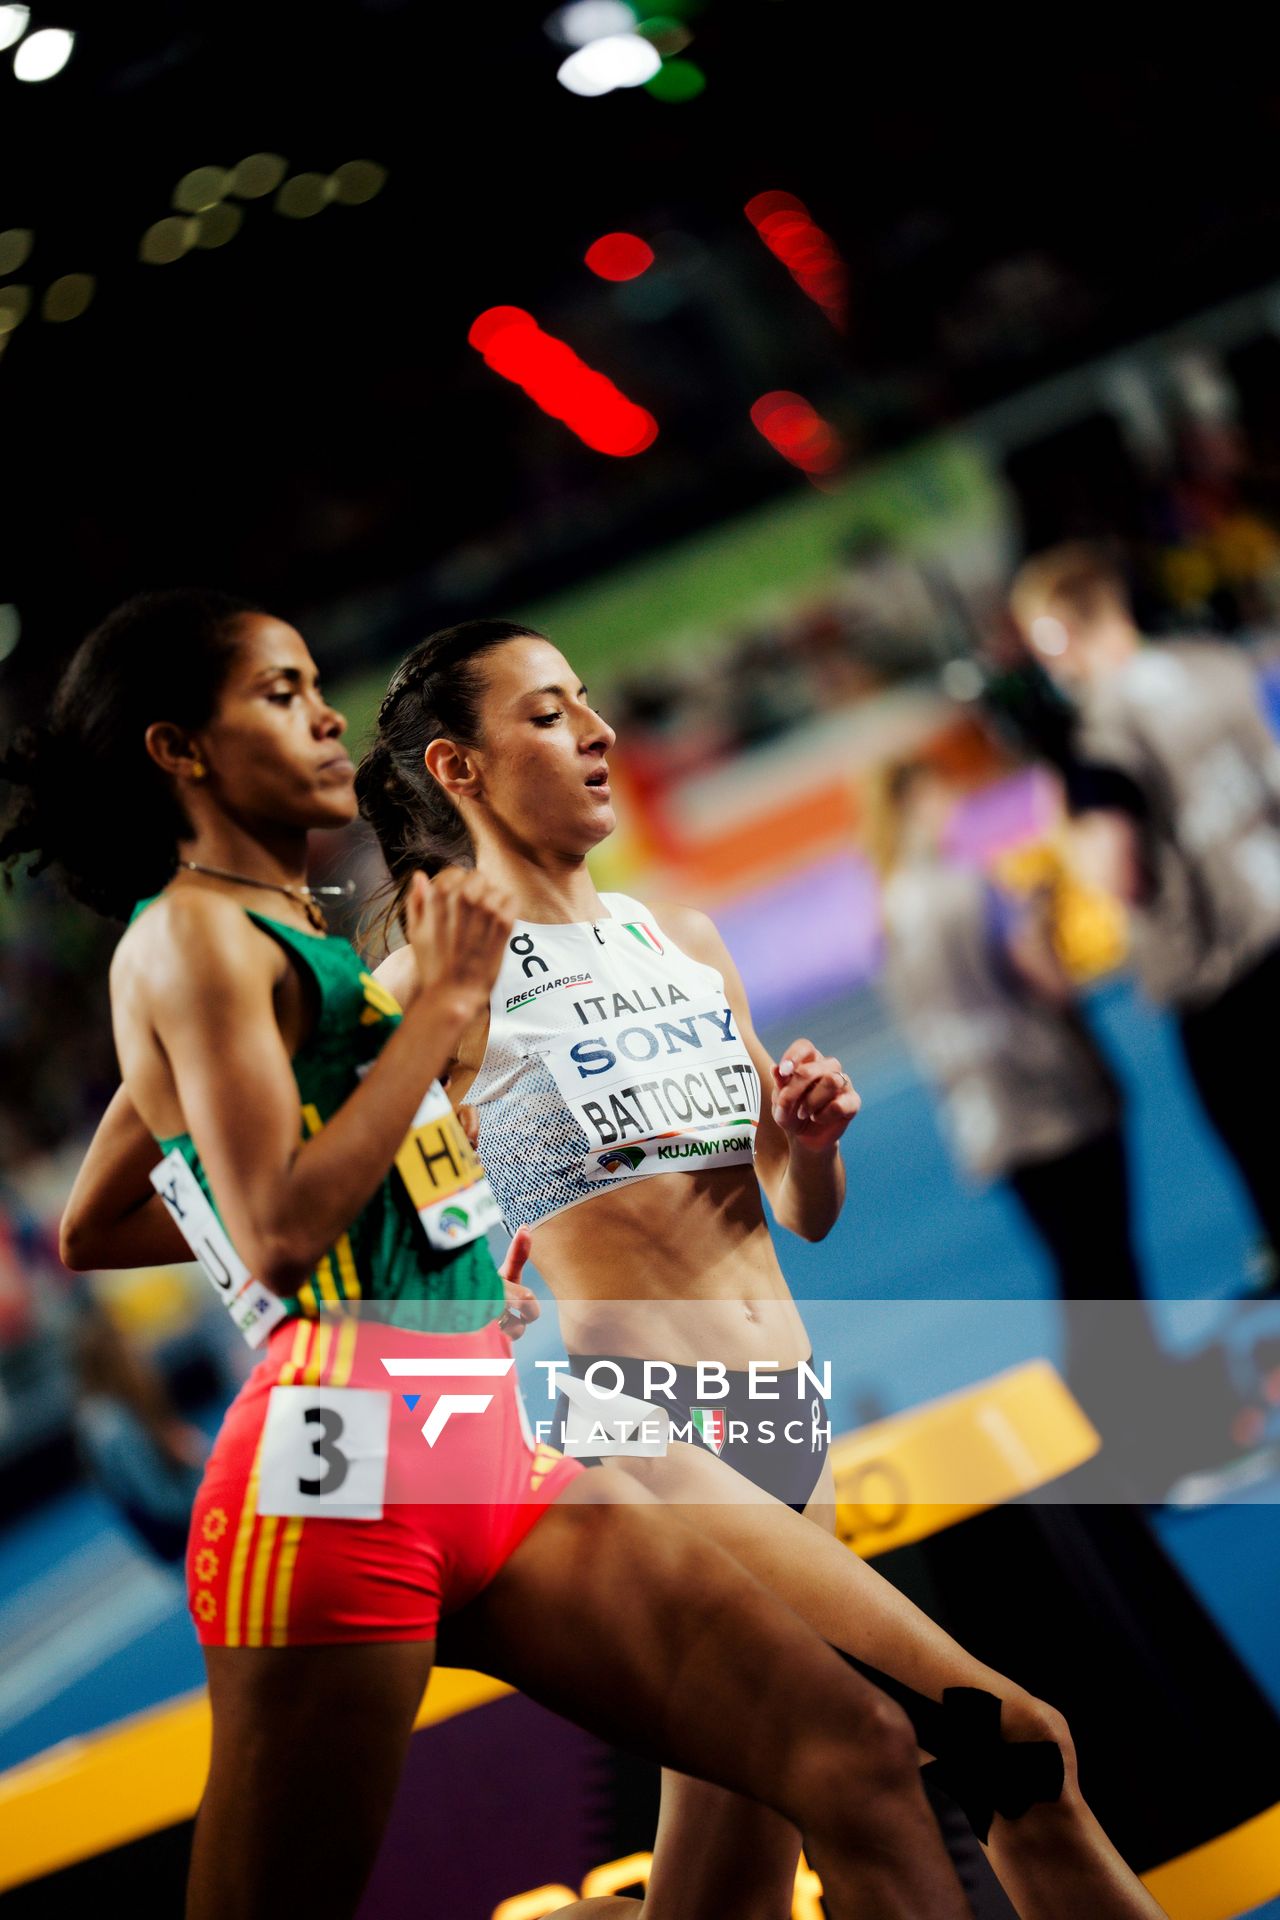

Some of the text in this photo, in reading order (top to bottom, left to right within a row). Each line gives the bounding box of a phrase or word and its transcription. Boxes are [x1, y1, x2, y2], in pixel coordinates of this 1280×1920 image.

[505, 972, 593, 1009] FRECCIAROSSA
[572, 983, 691, 1025] ITALIA
[569, 1008, 737, 1079] SONY
[657, 1141, 720, 1160] KUJAWY
[297, 1407, 349, 1496] 3
